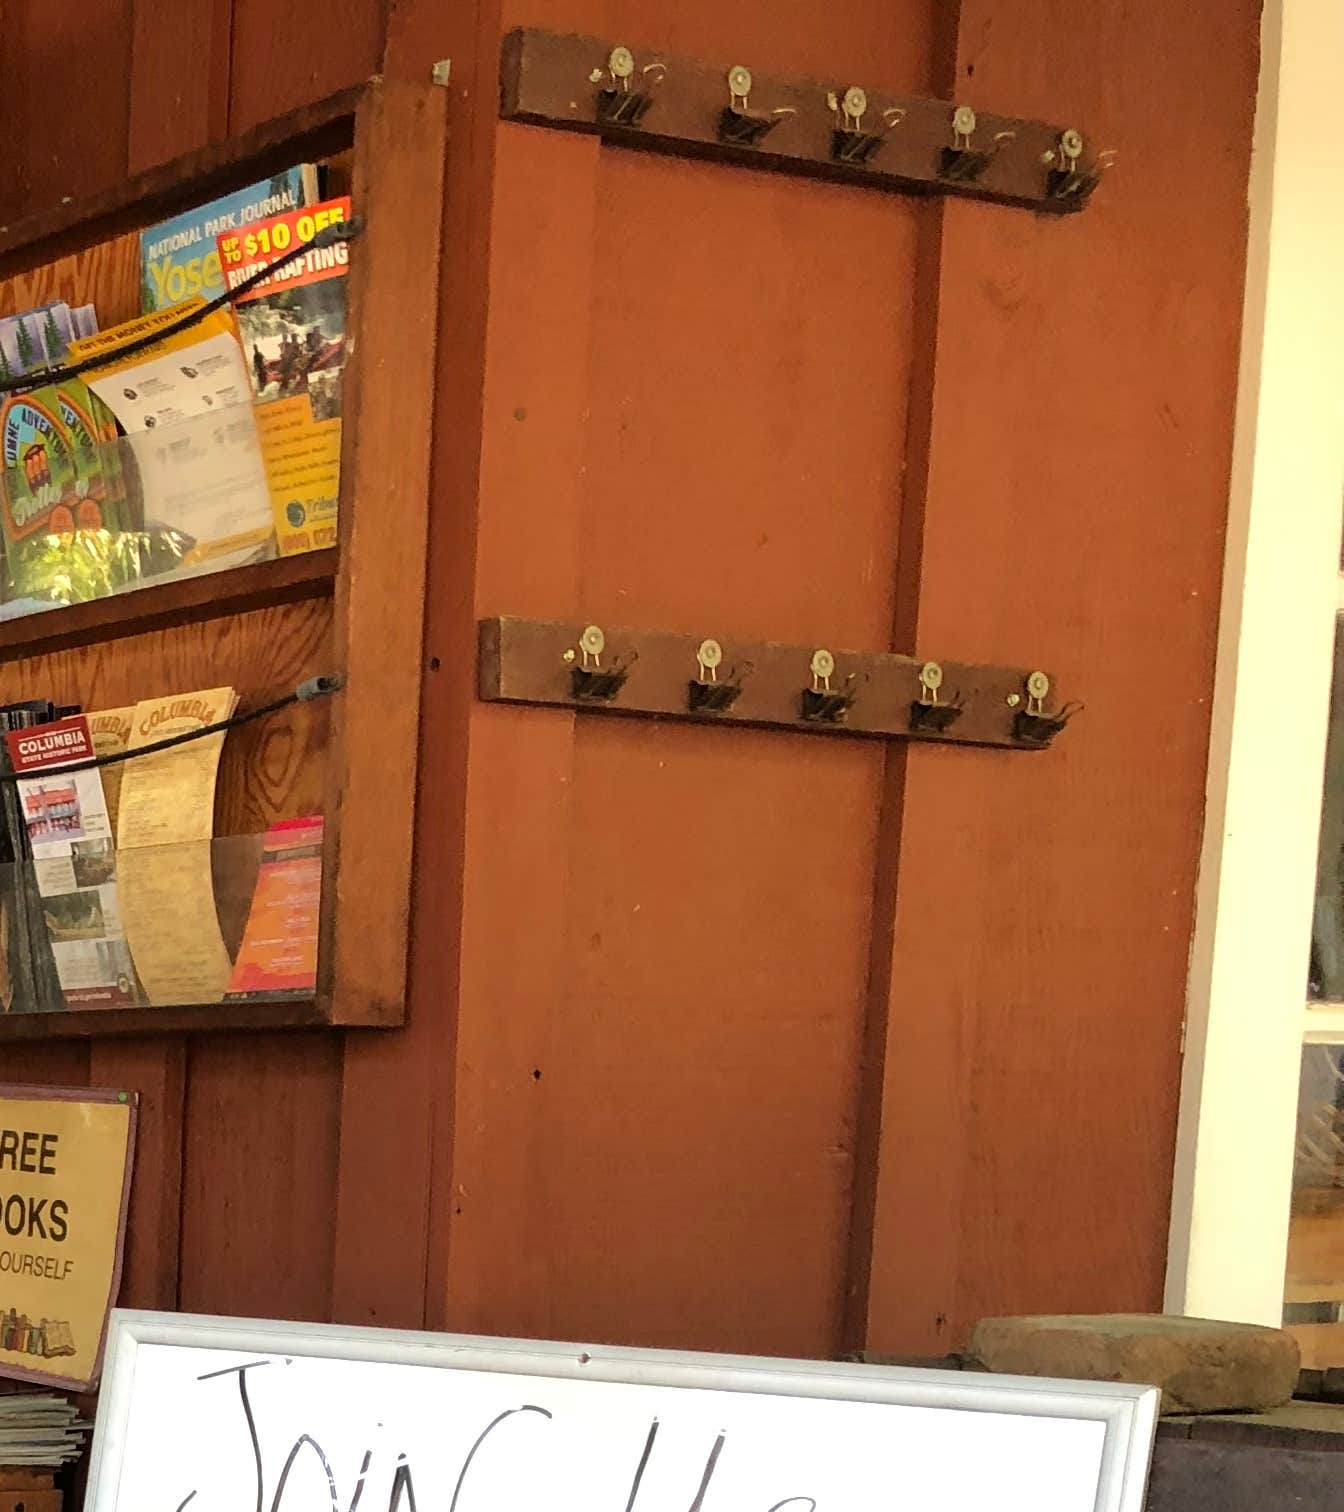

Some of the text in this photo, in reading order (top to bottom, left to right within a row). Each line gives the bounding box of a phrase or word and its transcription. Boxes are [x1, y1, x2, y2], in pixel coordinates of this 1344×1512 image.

[148, 190, 298, 260] NATIONAL PARK JOURNAL
[221, 237, 239, 253] UP
[244, 222, 291, 257] $10
[224, 250, 242, 264] TO
[149, 251, 223, 306] Yose
[18, 731, 85, 755] COLUMBIA
[91, 716, 132, 744] UMBIA
